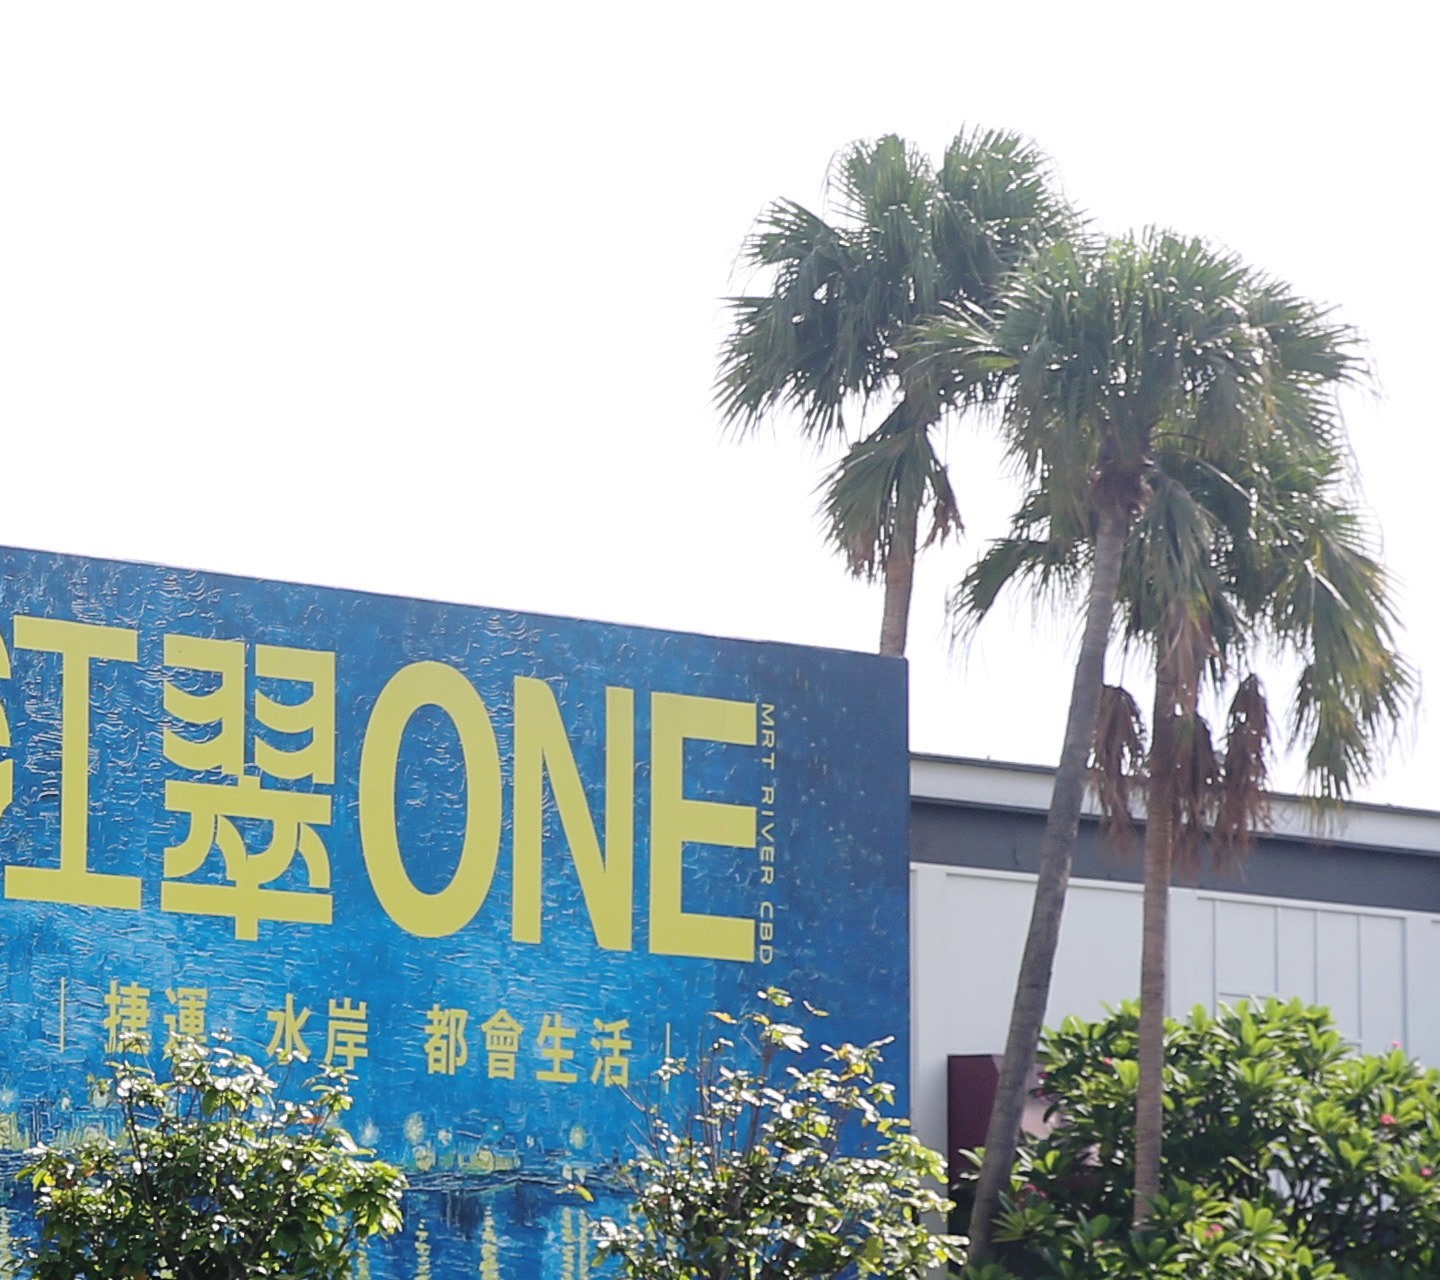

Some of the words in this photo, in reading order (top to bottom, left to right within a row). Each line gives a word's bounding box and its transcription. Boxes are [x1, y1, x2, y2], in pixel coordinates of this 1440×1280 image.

[760, 703, 776, 770] MRT
[759, 786, 775, 885] RIVER
[758, 901, 774, 965] CBD
[266, 993, 369, 1071] 水岸
[425, 1003, 633, 1088] 都會生活
